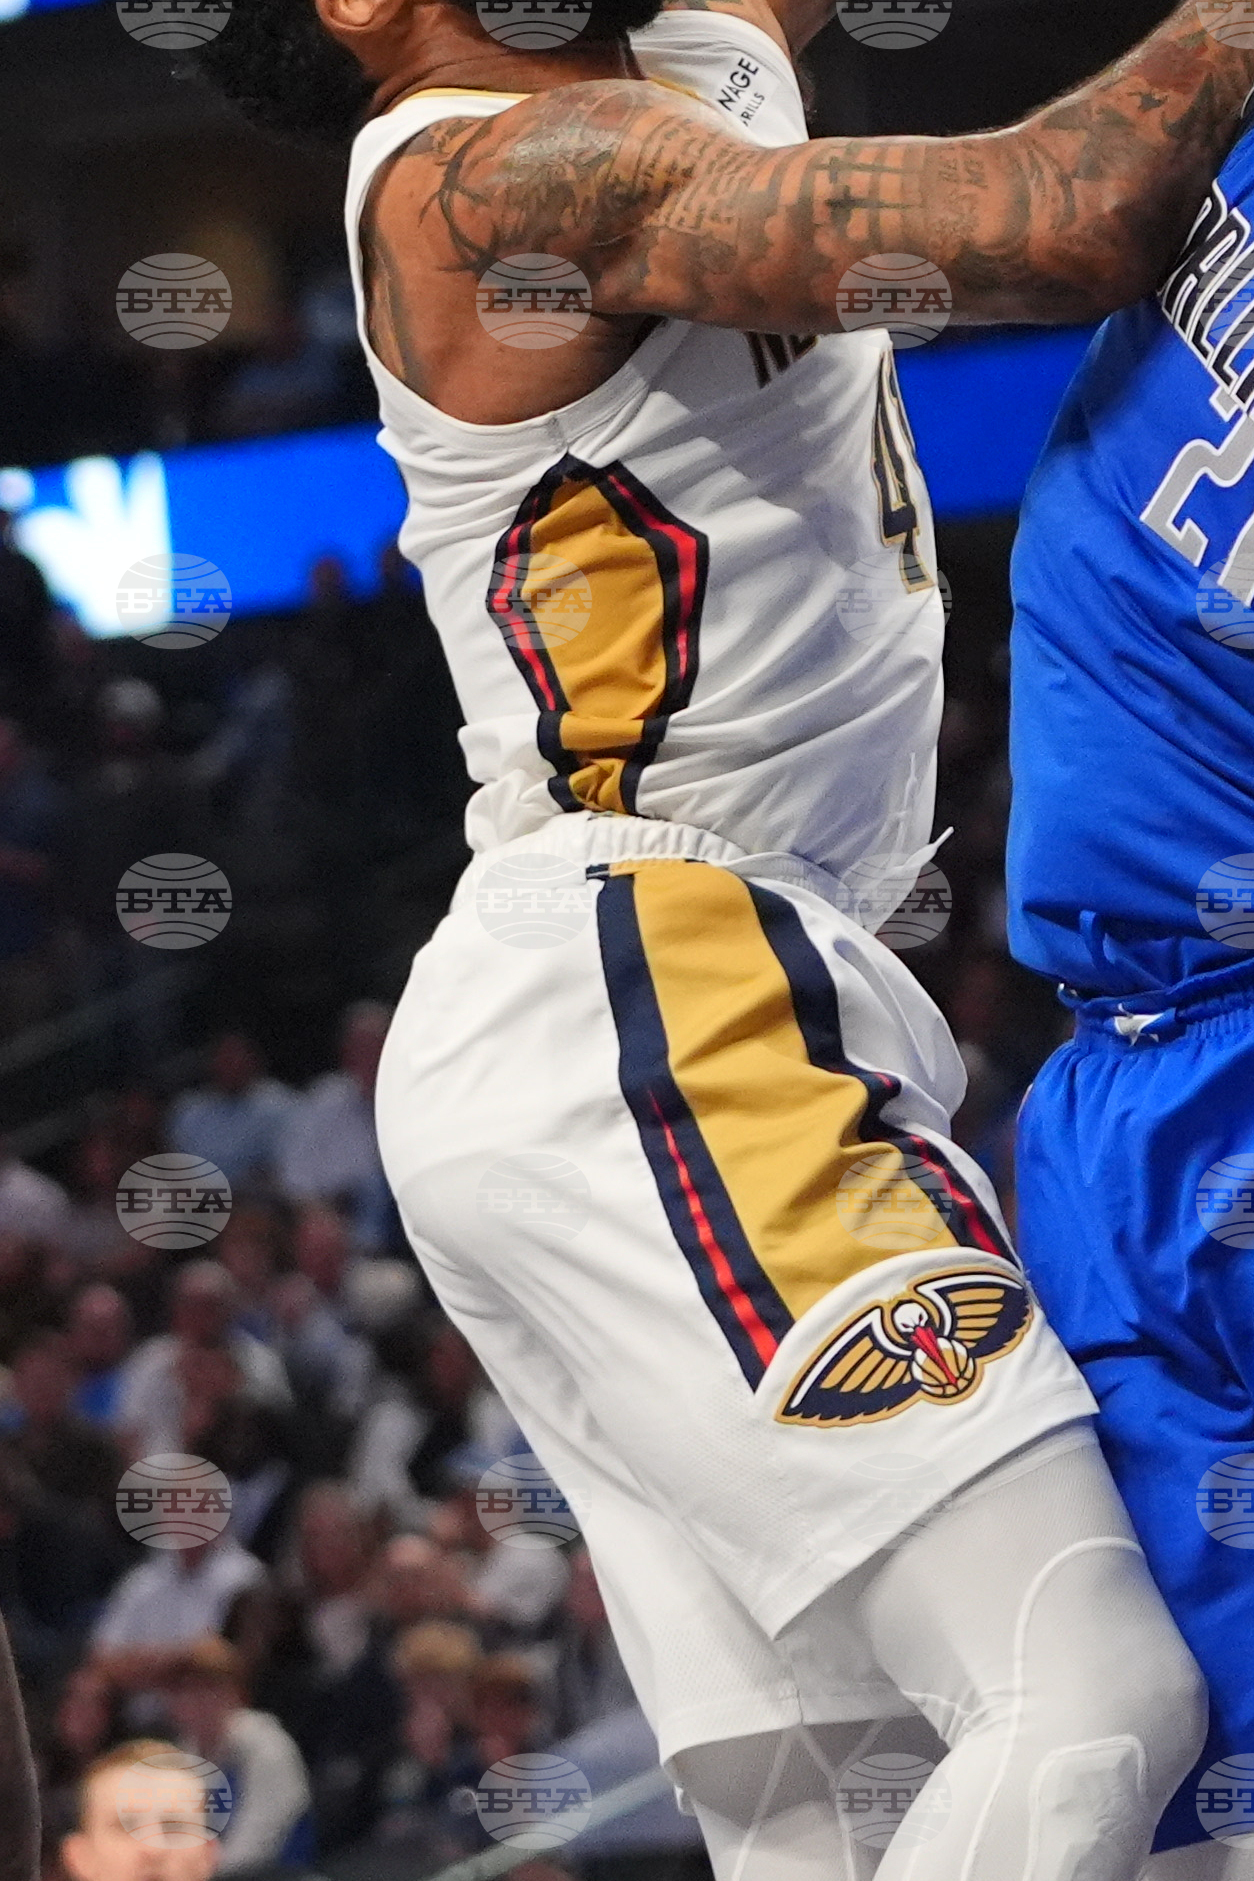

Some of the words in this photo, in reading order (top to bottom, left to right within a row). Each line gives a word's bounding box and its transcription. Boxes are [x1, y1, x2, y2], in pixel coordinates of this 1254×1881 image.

[717, 56, 759, 112] NAGE
[740, 92, 765, 127] RILLS
[871, 346, 935, 595] 4
